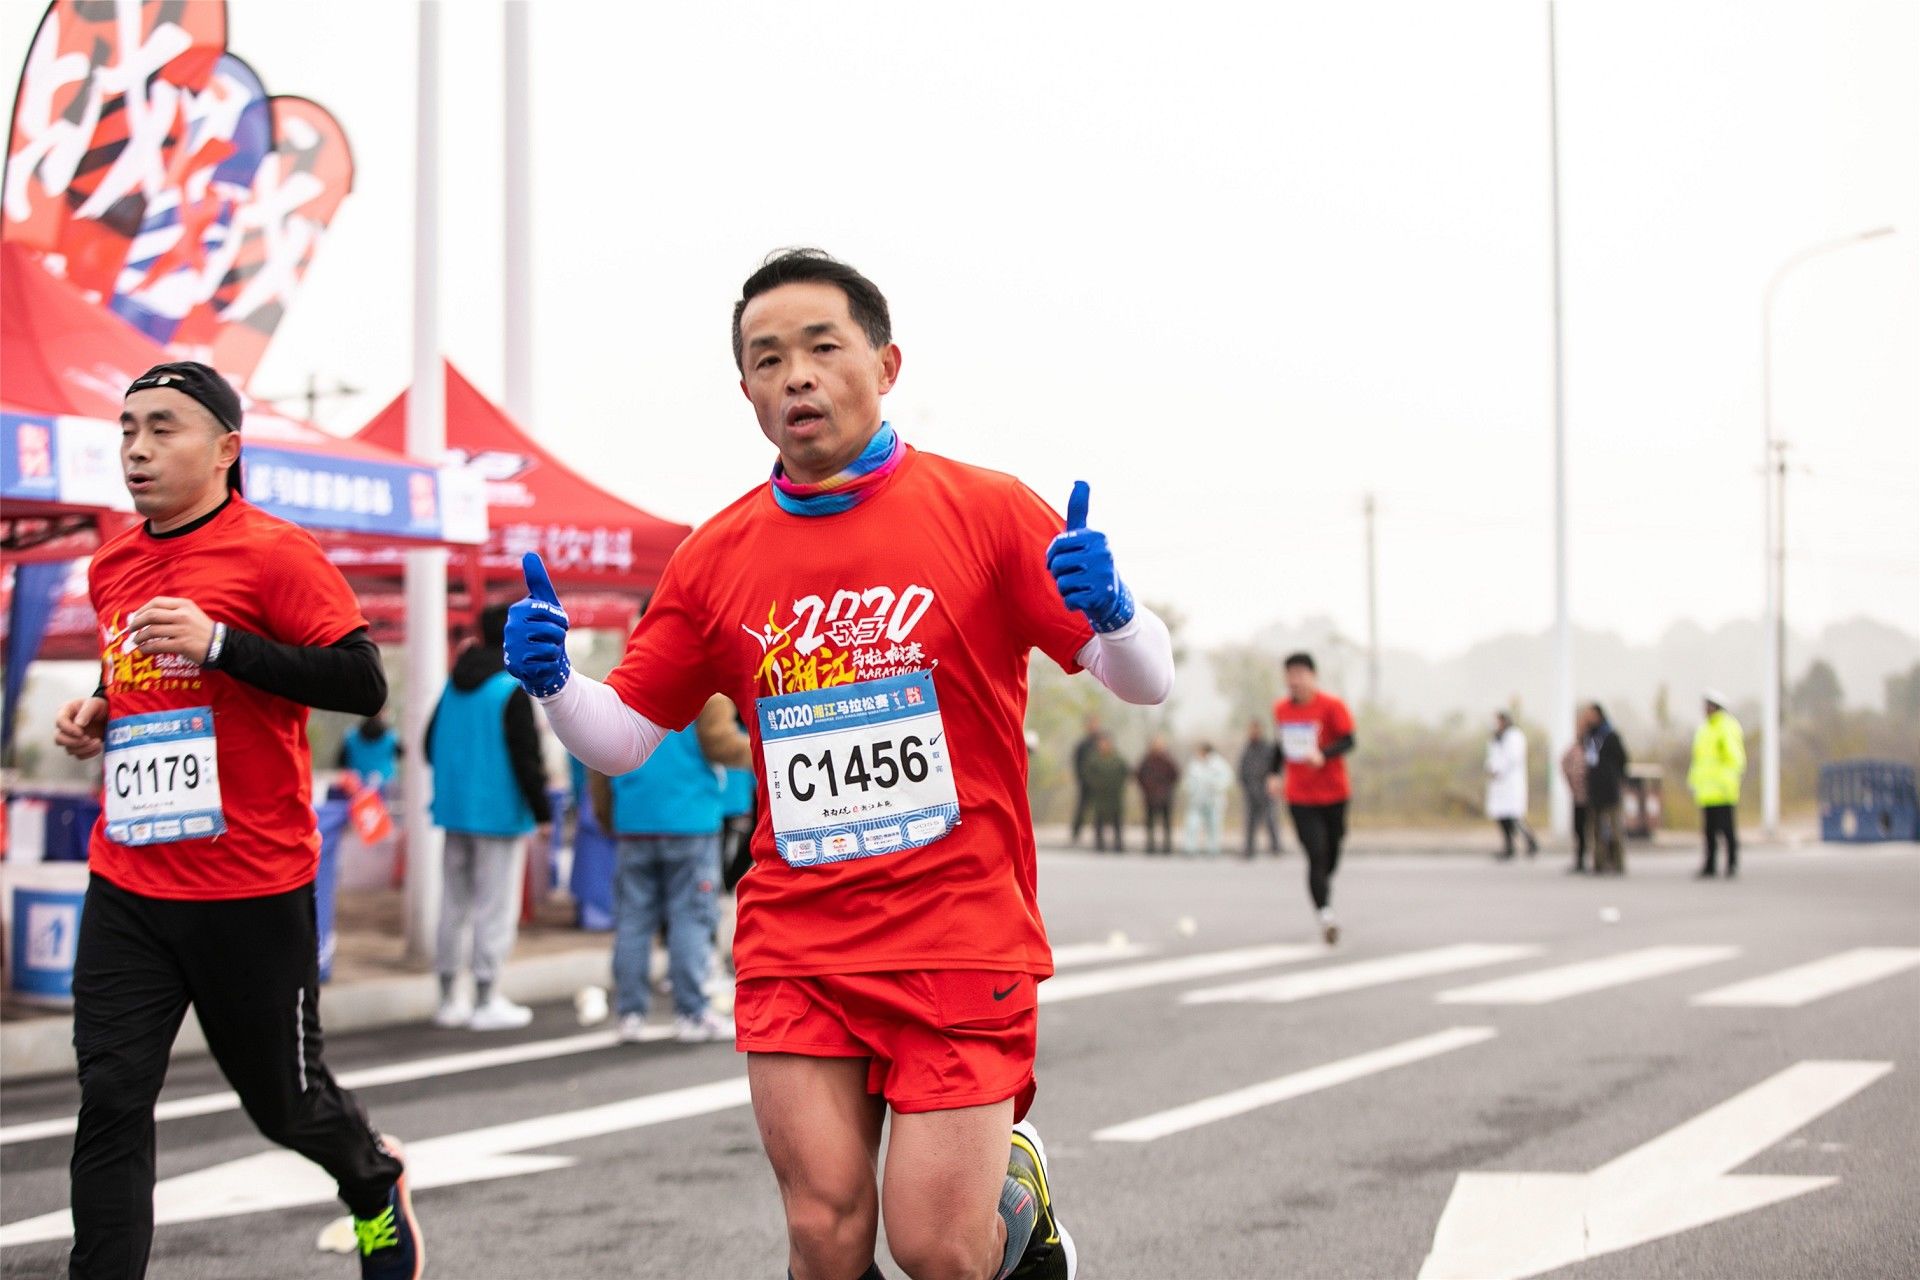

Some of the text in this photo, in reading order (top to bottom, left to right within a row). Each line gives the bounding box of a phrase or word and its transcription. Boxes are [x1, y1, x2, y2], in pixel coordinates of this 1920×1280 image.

[792, 584, 935, 657] 2020
[851, 641, 925, 668] 马拉松赛
[856, 665, 921, 680] MARATHON
[777, 704, 814, 730] 2020
[114, 753, 200, 798] C1179
[788, 735, 929, 802] C1456
